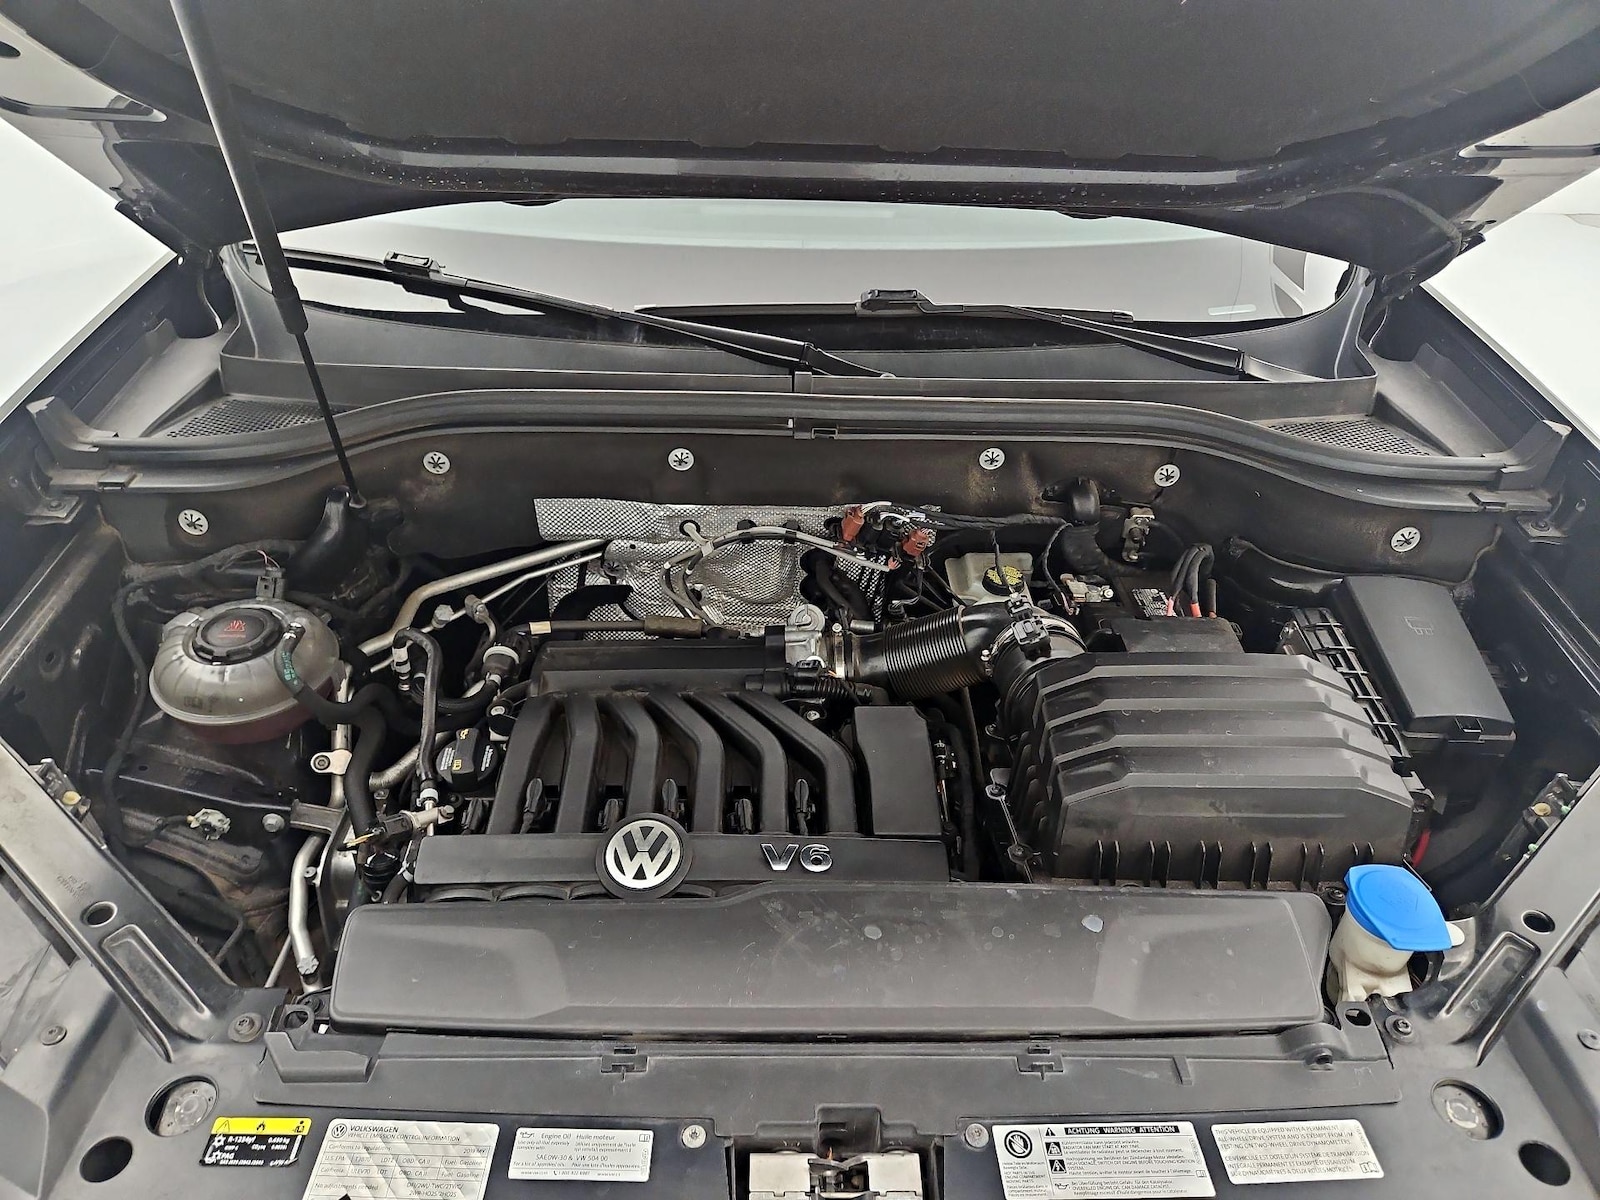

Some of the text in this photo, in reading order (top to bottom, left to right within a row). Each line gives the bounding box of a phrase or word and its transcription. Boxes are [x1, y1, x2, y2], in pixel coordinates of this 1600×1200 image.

[760, 843, 833, 873] V6
[350, 1125, 399, 1133] VOLKSWAGEN
[541, 1132, 562, 1141] Engine
